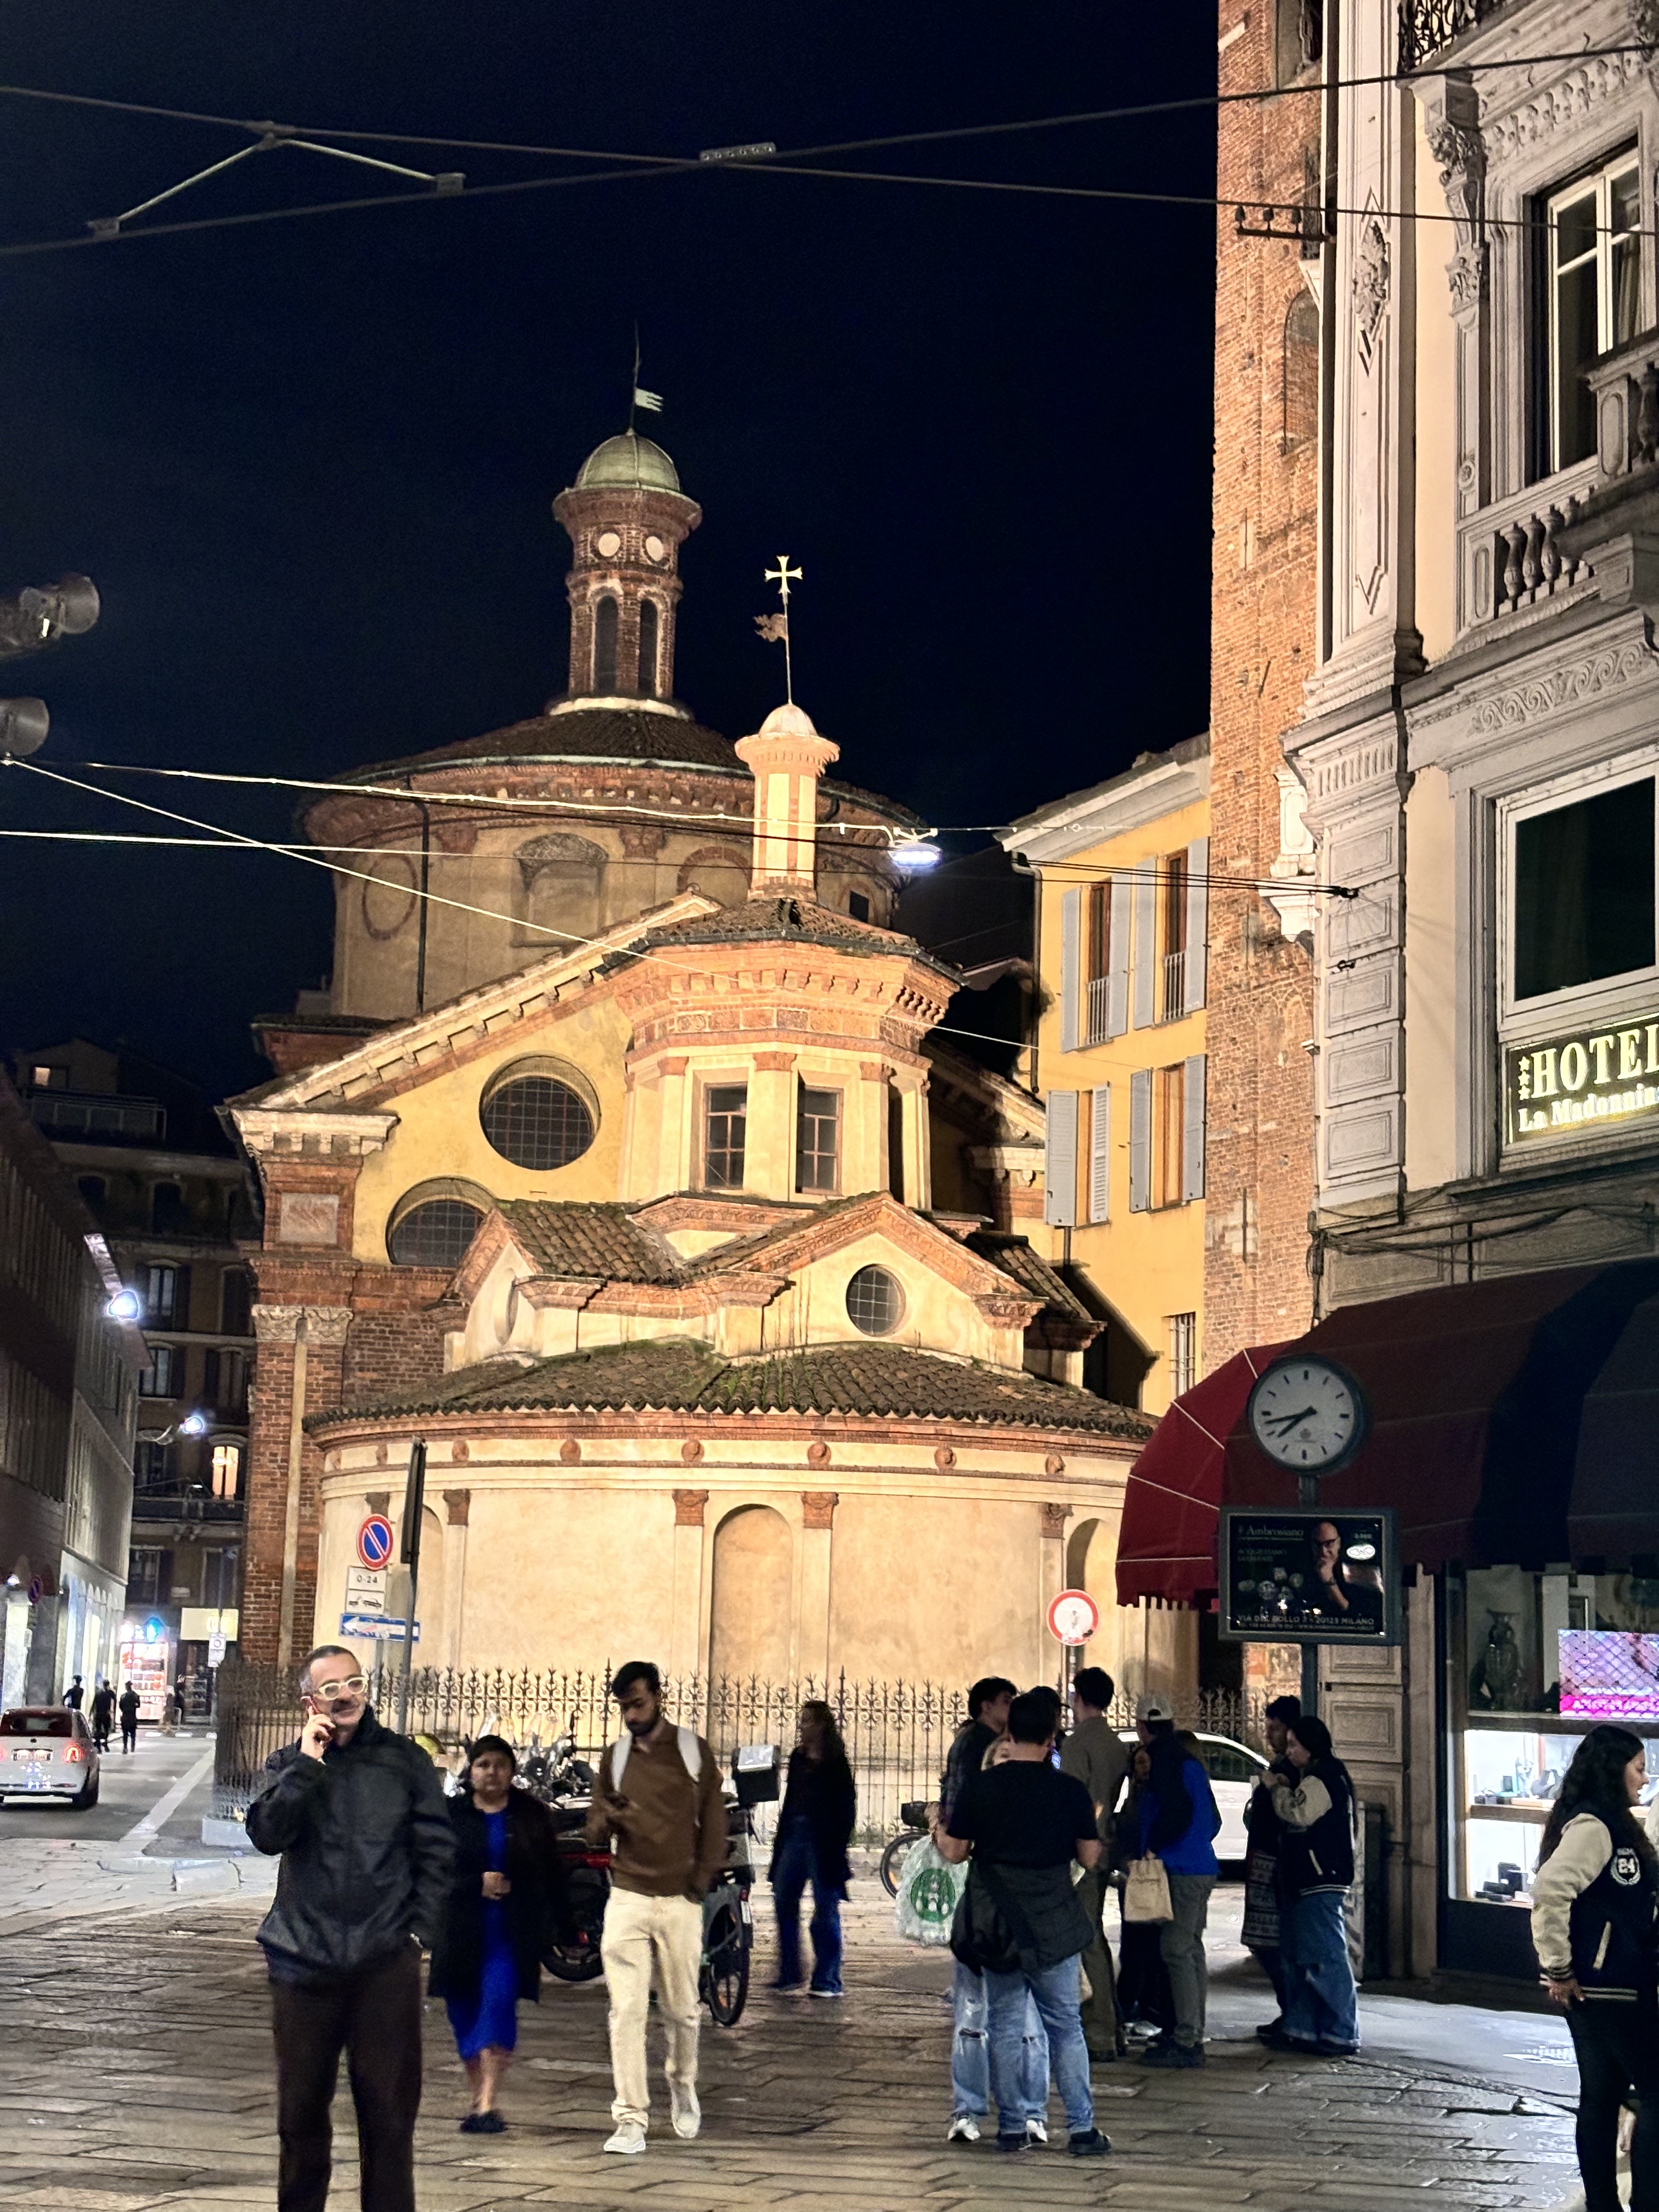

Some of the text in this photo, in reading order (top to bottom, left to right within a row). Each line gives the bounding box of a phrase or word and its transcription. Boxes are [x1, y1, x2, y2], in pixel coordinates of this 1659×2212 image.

[1518, 1083, 1659, 1132] La Madonnin
[1246, 1524, 1305, 1536] Ambrosiano
